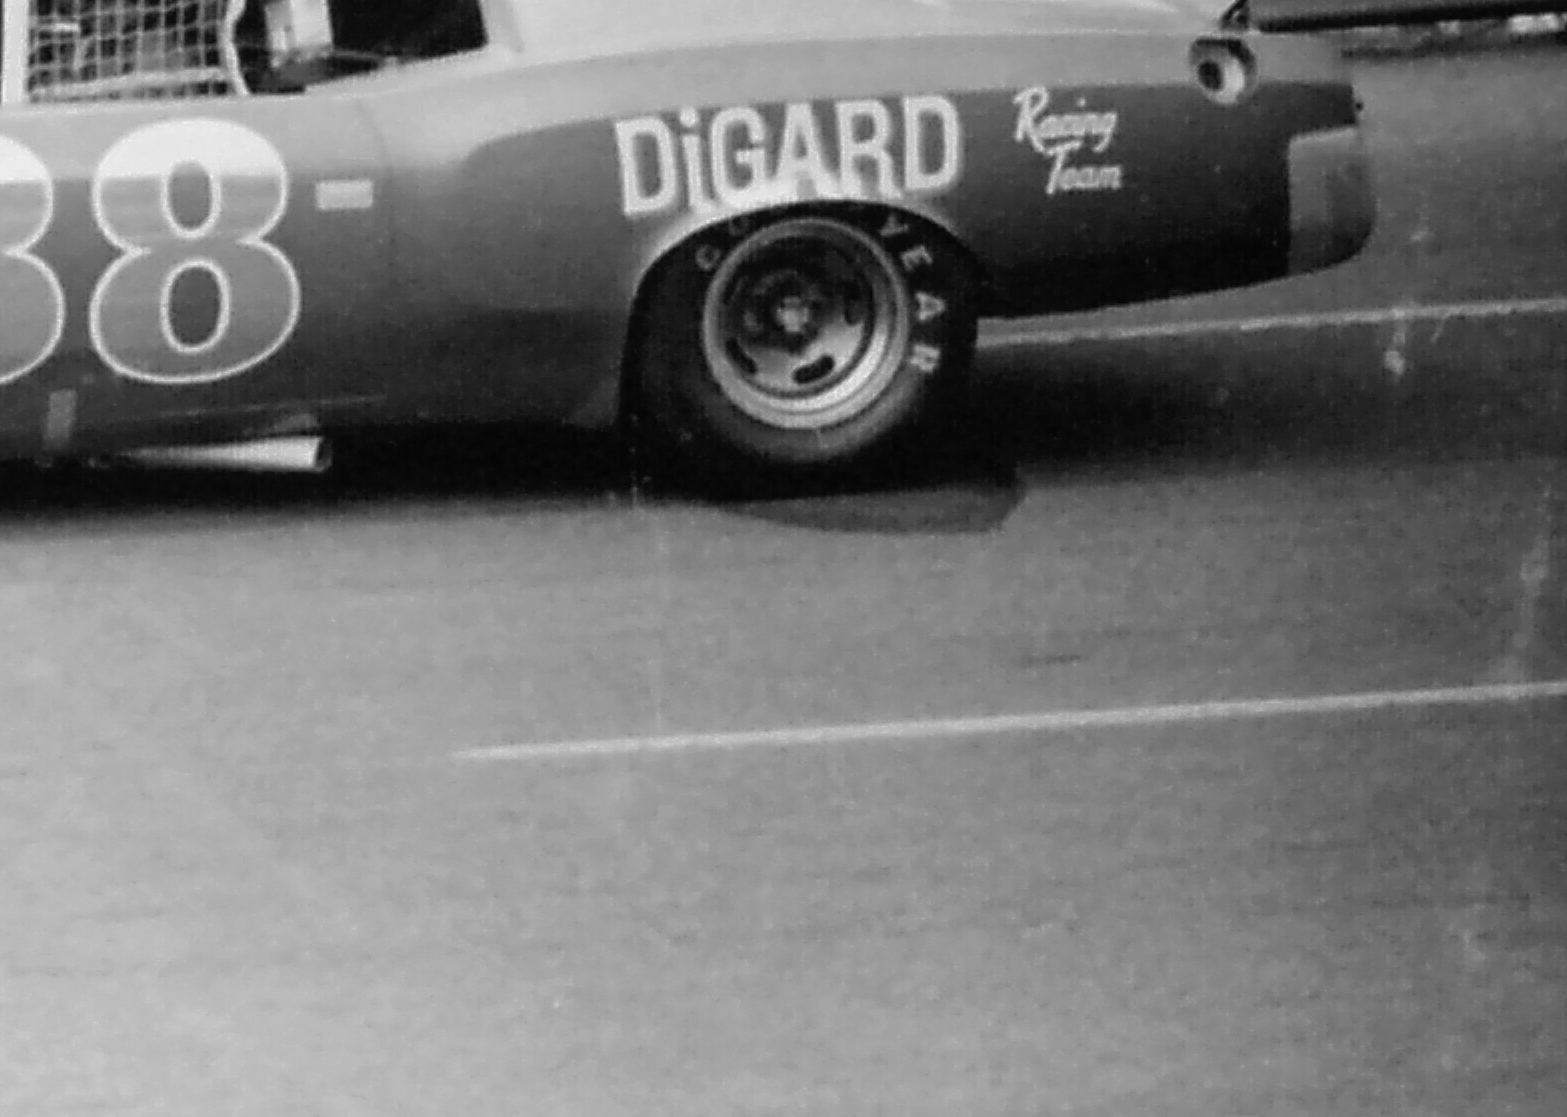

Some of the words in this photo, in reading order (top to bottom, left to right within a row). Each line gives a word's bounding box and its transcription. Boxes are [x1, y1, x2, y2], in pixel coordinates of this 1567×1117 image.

[1012, 85, 1117, 153] Racing
[614, 94, 961, 217] DiGARD
[1043, 139, 1123, 195] Team
